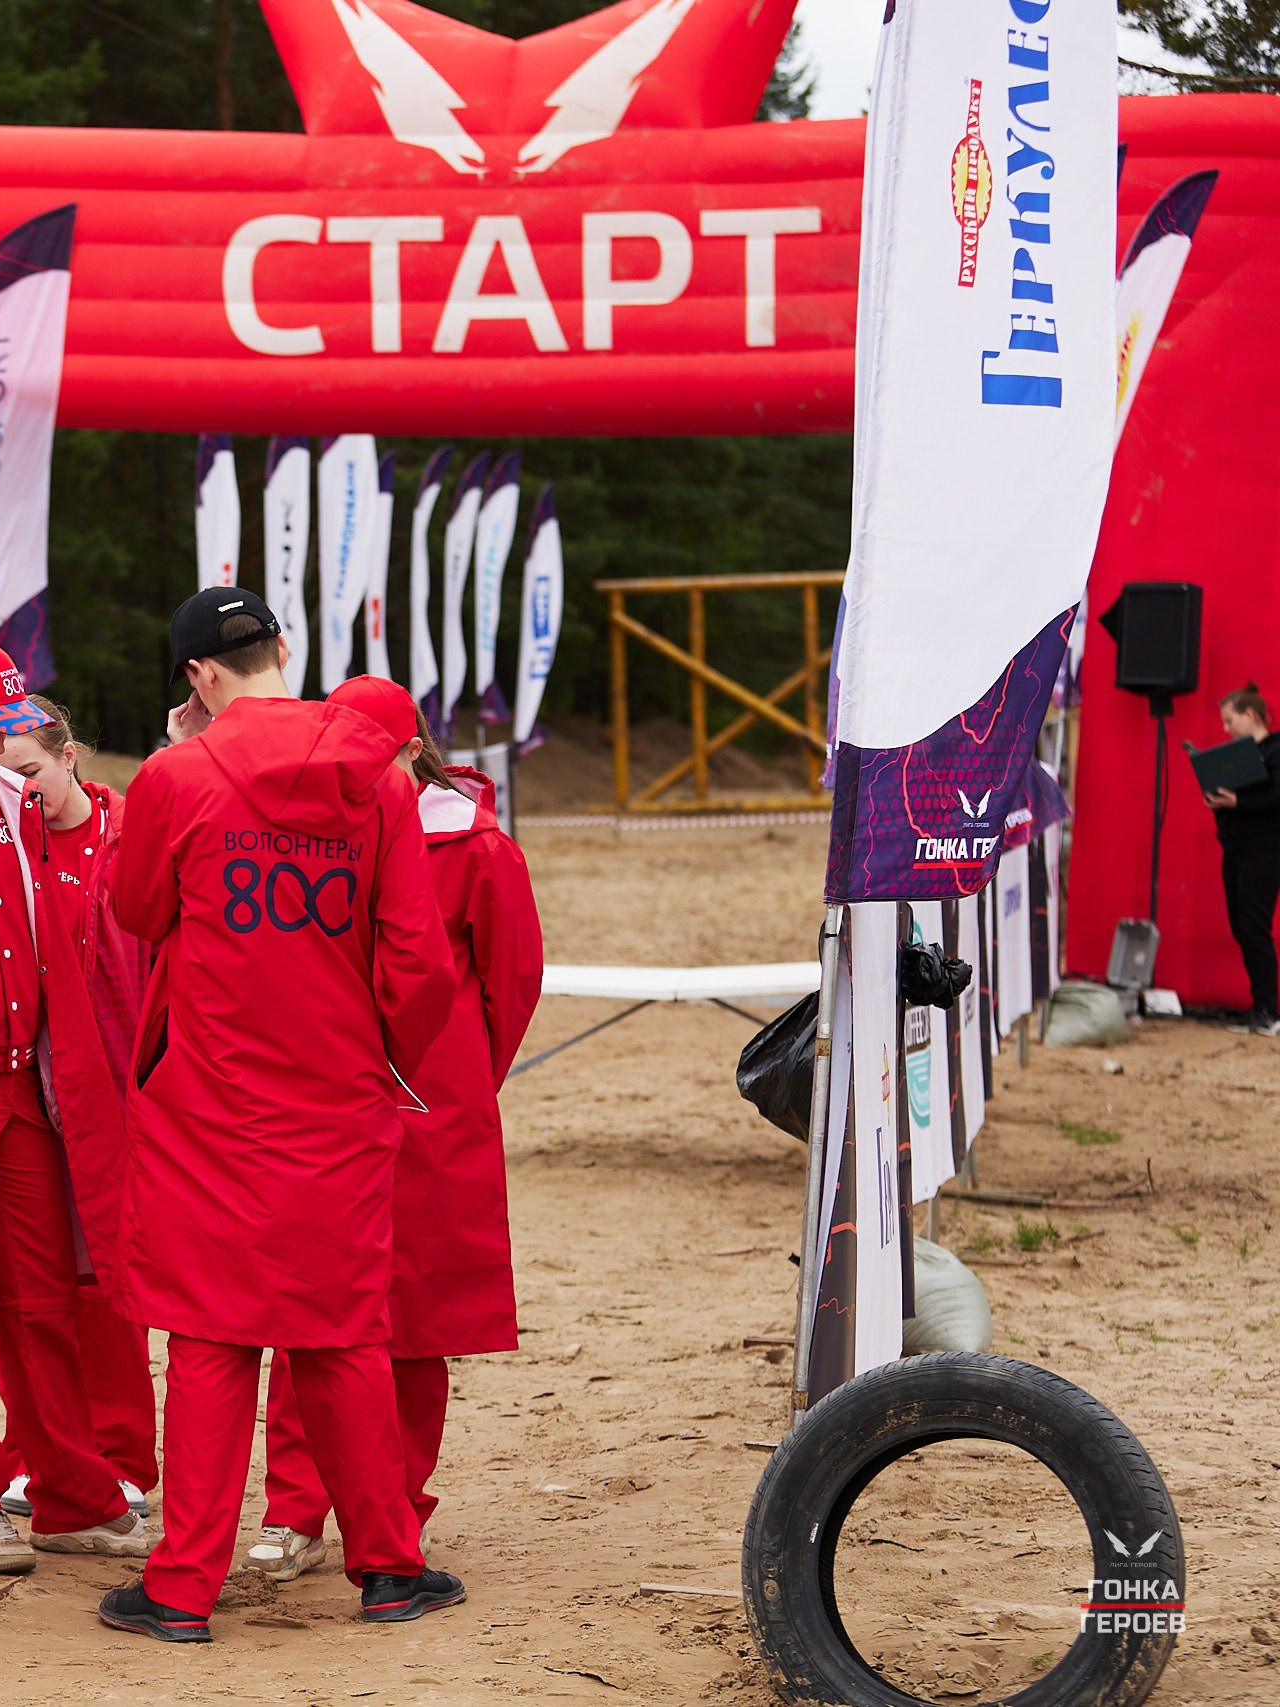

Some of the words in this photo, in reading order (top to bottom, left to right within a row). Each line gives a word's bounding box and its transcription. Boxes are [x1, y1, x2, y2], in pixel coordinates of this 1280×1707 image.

[967, 82, 982, 181] ПРОДУКТ
[222, 206, 821, 356] СТАРТ
[915, 838, 968, 860] ГОНКА
[223, 859, 356, 937] 800
